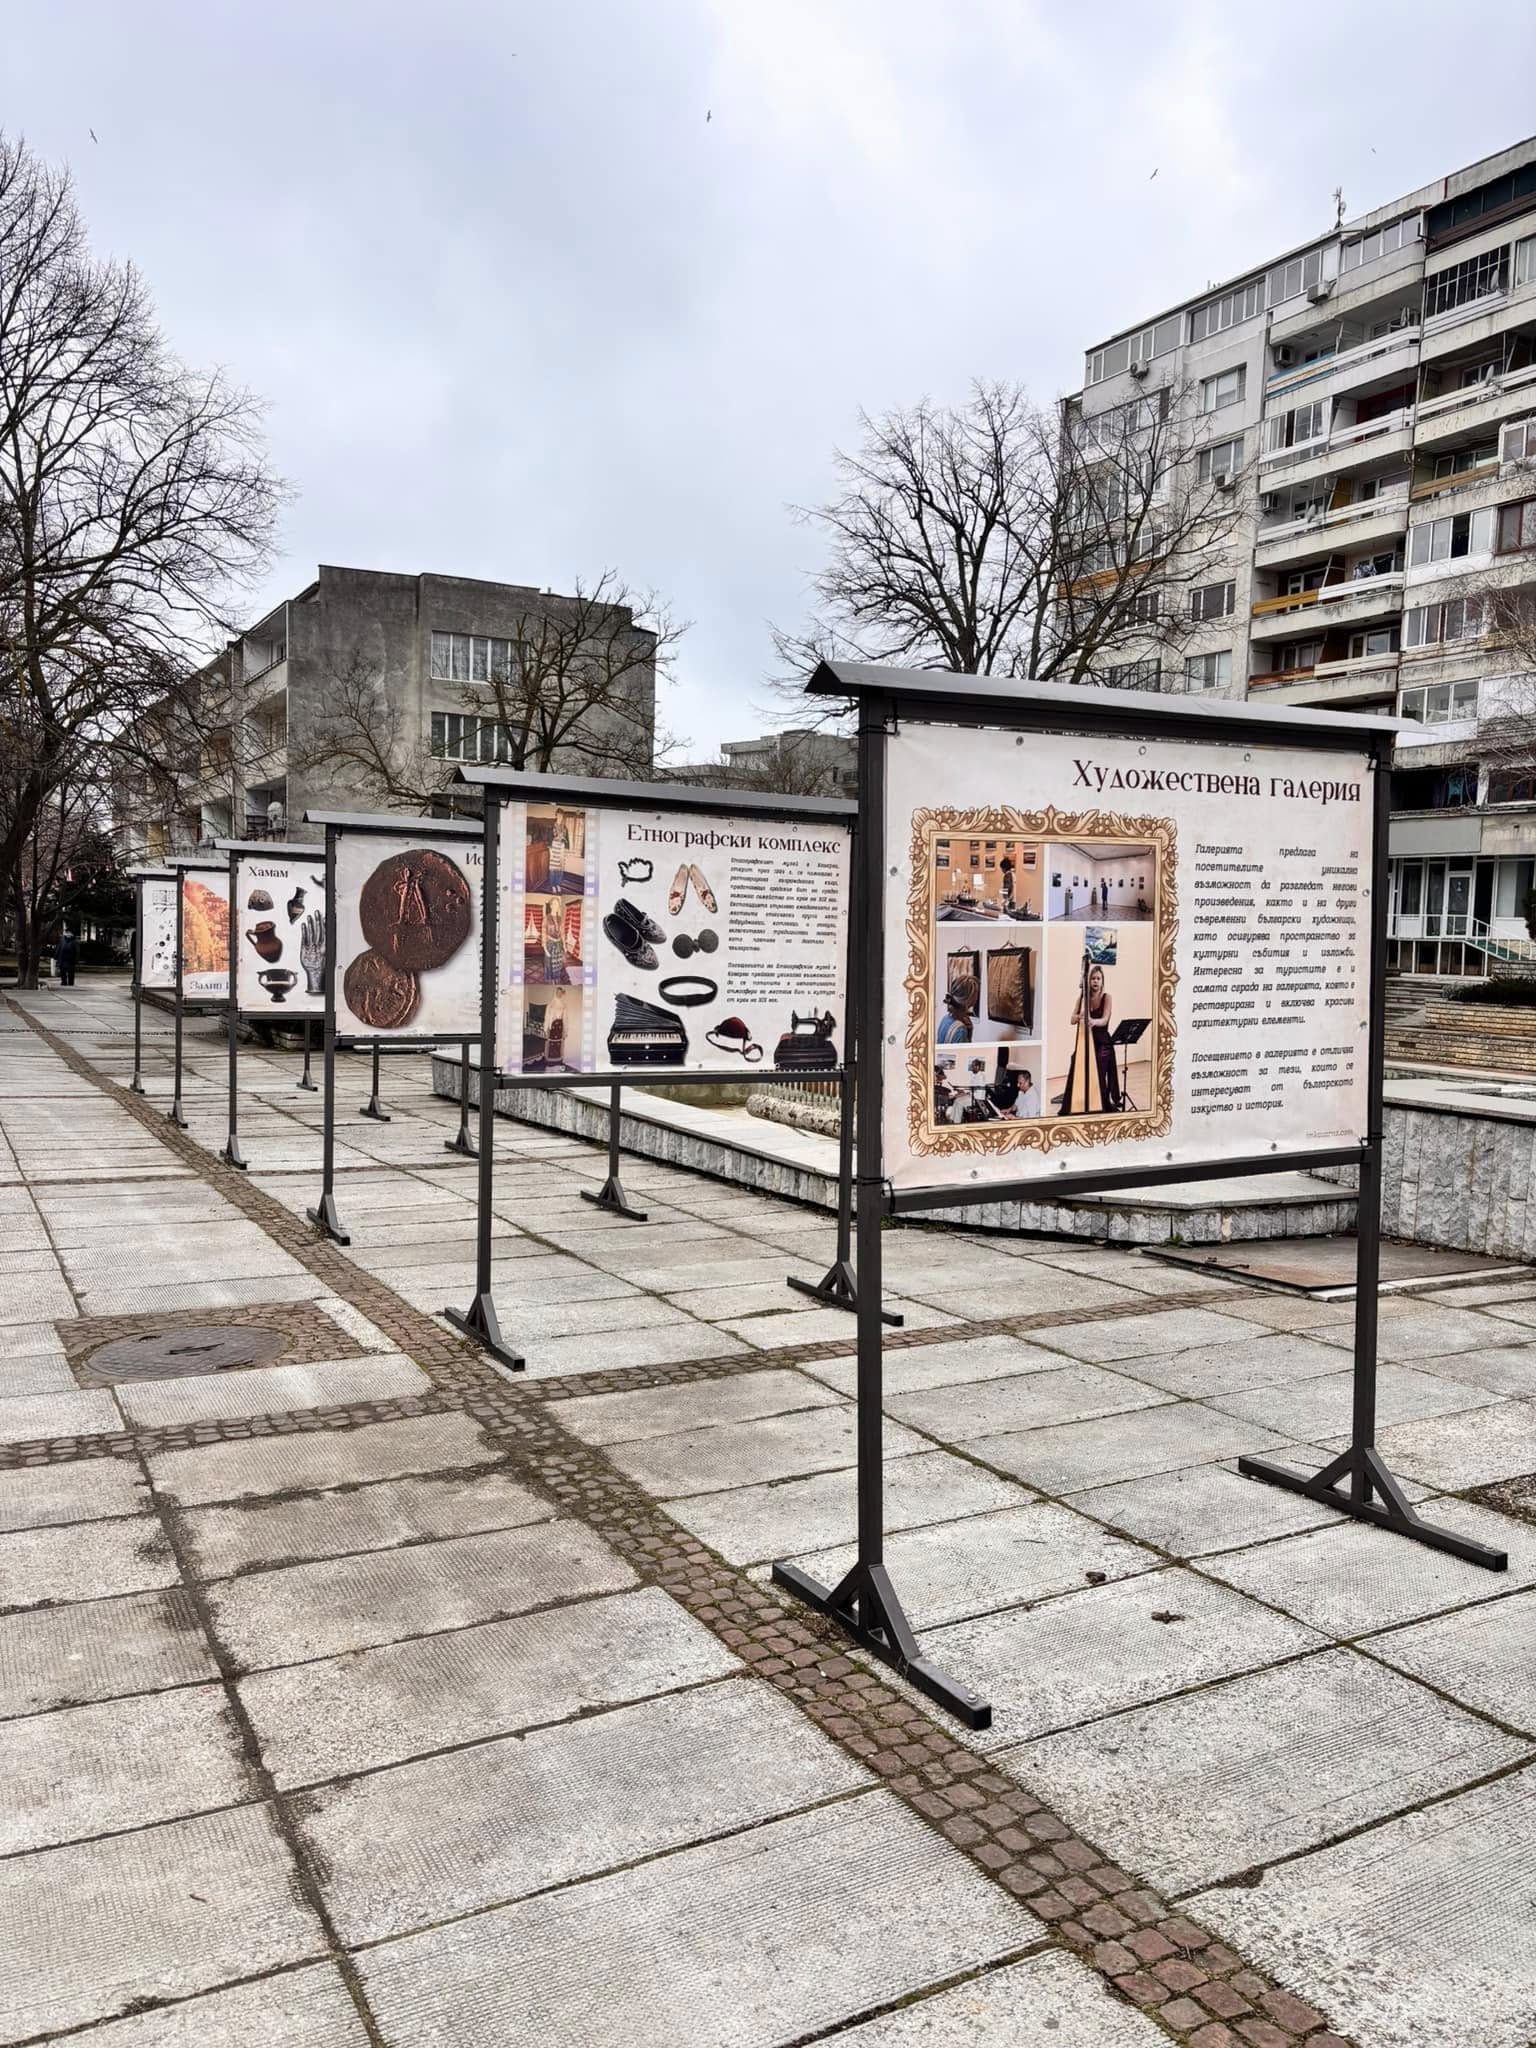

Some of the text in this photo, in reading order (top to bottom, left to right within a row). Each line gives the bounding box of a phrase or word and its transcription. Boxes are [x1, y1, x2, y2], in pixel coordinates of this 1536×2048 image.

[1072, 759, 1361, 805] Художествена галерия
[627, 823, 841, 855] Етнографски комплекс
[1195, 844, 1243, 855] Галерията
[1279, 846, 1316, 859] предлага
[248, 866, 289, 879] Хамам
[1194, 862, 1264, 872] посетителите
[1194, 880, 1252, 889] възможност
[1260, 879, 1270, 889] да
[1279, 880, 1323, 892] разгледат
[1265, 898, 1293, 907] както
[1302, 899, 1308, 907] и
[1316, 899, 1327, 907] на
[1335, 897, 1357, 910] други
[1193, 915, 1246, 926] съвременни
[1257, 913, 1301, 926] български
[1193, 933, 1218, 941] като
[1227, 932, 1270, 943] осигурява
[1280, 932, 1341, 943] пространство
[1193, 950, 1239, 961] културни
[1252, 947, 1290, 957] събития
[1302, 949, 1308, 957] и
[1192, 965, 1242, 978] Интересна
[1253, 966, 1264, 974] за
[1275, 965, 1326, 976] туристите
[1336, 965, 1341, 973] е
[1192, 984, 1228, 993] самата
[1230, 981, 1259, 994] сграда
[1262, 983, 1273, 991] на
[1350, 981, 1355, 989] е
[1192, 1000, 1255, 1013] реставрирана
[1265, 1000, 1271, 1008] и
[1280, 999, 1315, 1007] включва
[1192, 1015, 1305, 1030] архитектурни елементи.
[1191, 1050, 1252, 1063] Посещението
[1256, 1051, 1261, 1059] в
[1263, 1048, 1308, 1061] галерията
[1311, 1048, 1316, 1056] е
[1190, 1068, 1248, 1079] възможност
[1258, 1067, 1268, 1075] за
[1310, 1063, 1337, 1072] които
[1345, 1062, 1354, 1070] се
[1191, 1079, 1354, 1098] интересуват от българското
[1190, 1102, 1233, 1115] изкуство
[1236, 1102, 1242, 1110] и
